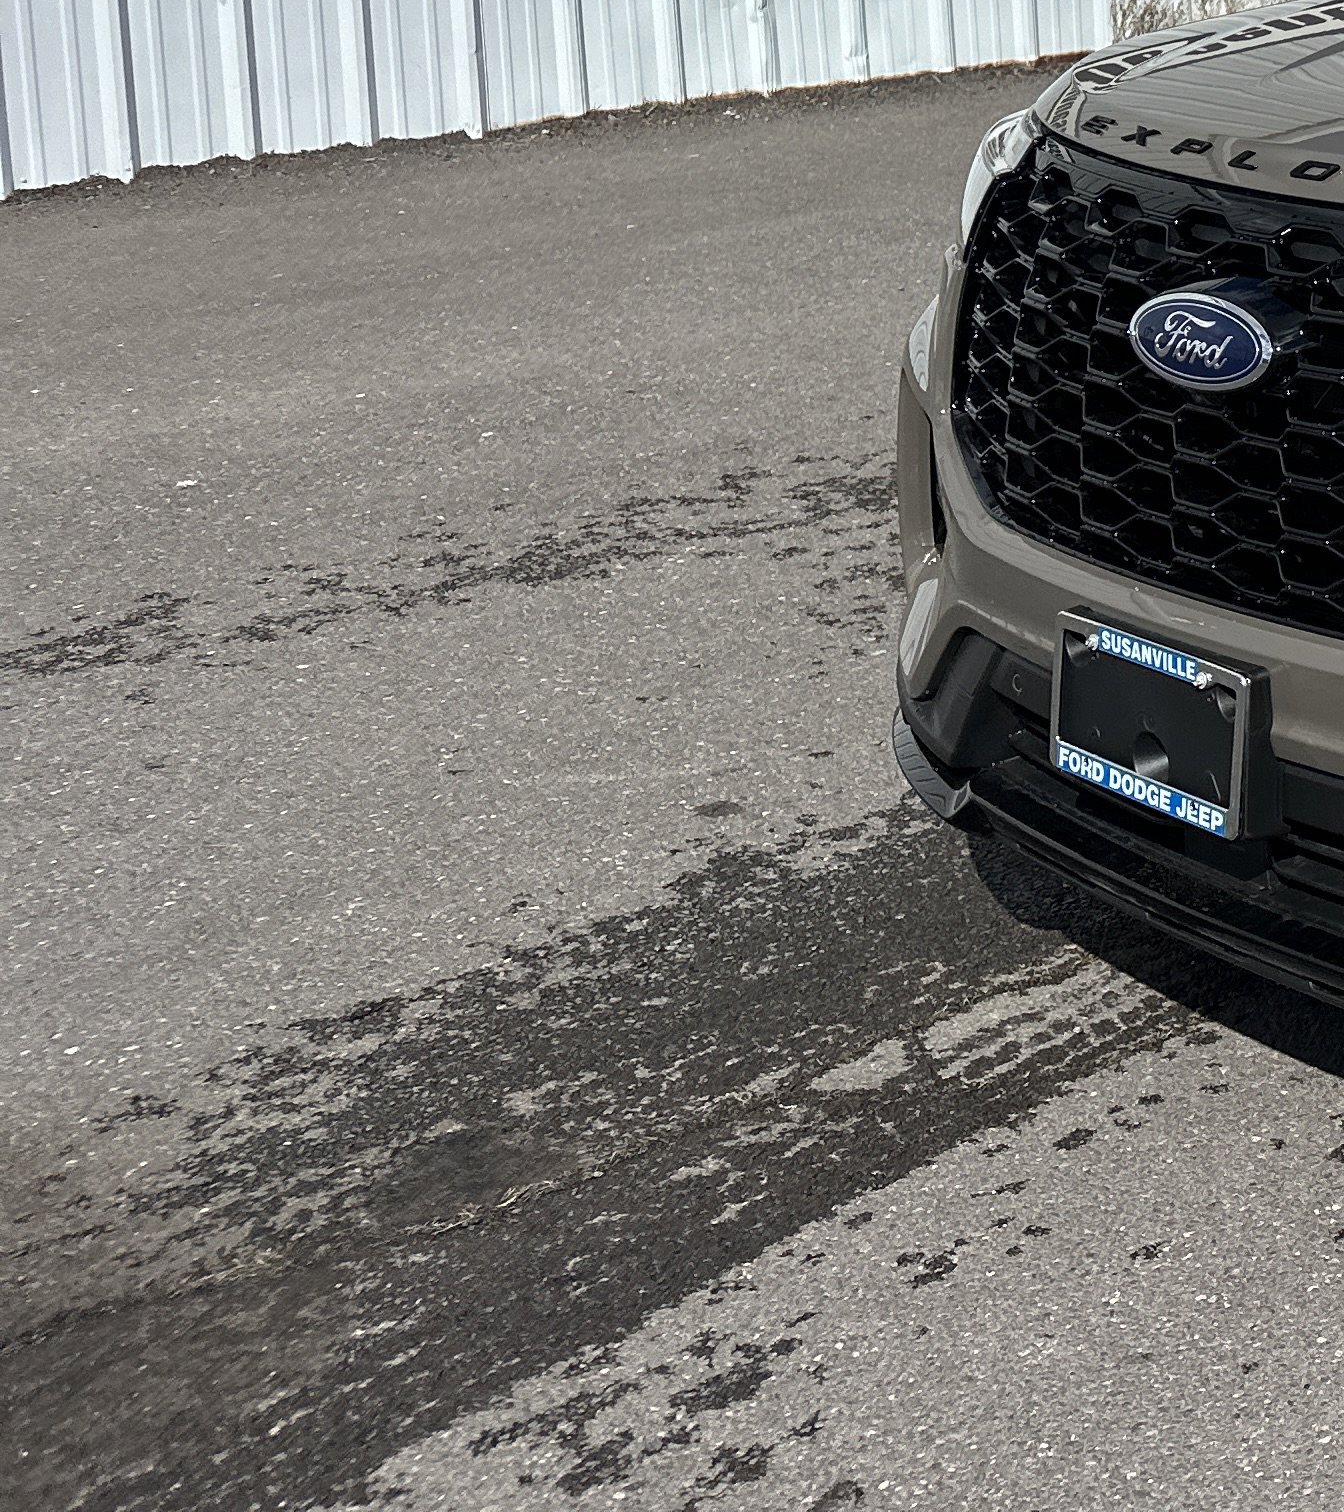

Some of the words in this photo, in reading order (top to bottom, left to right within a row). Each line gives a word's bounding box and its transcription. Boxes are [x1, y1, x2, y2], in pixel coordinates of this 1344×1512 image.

[1154, 309, 1232, 371] Ford
[1100, 629, 1196, 681] SUSANVILLE
[1057, 746, 1105, 783] FORD
[1109, 769, 1172, 812] DODGE
